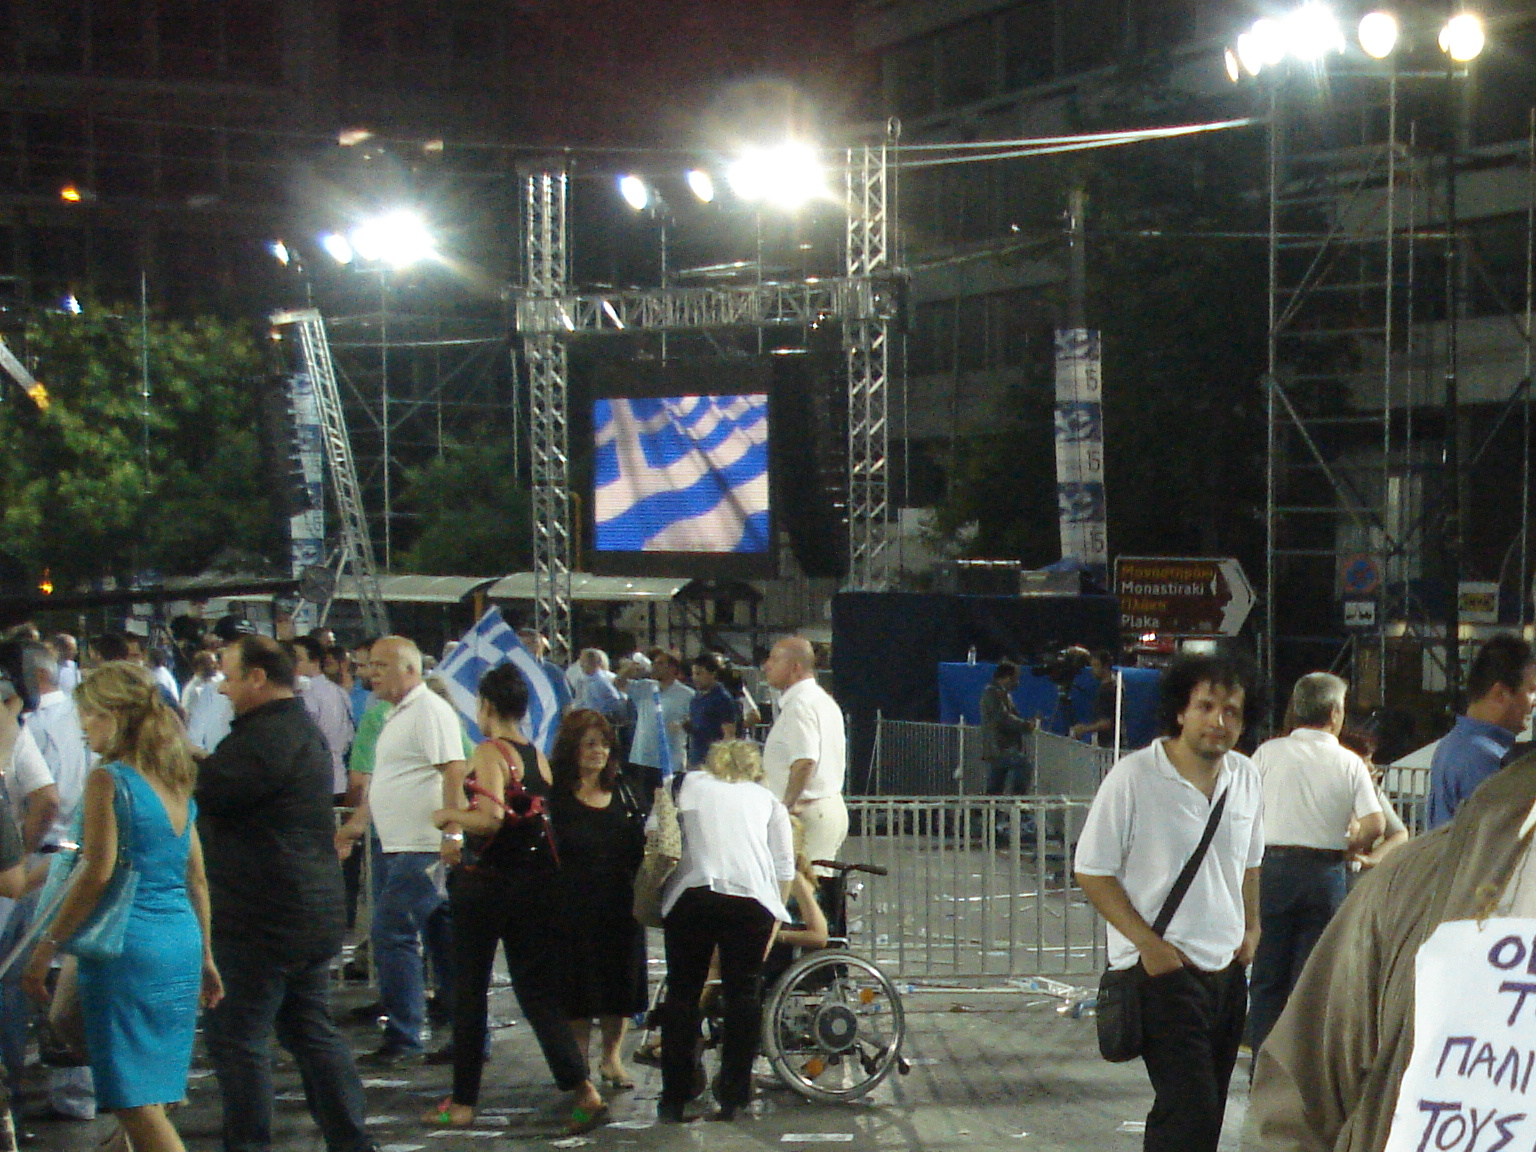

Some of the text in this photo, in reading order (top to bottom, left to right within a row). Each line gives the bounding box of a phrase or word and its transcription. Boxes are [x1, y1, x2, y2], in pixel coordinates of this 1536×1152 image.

[1121, 581, 1205, 596] Monastiraki
[1121, 613, 1160, 629] Plaka
[1434, 1036, 1534, 1095] ΠΑΛΙ
